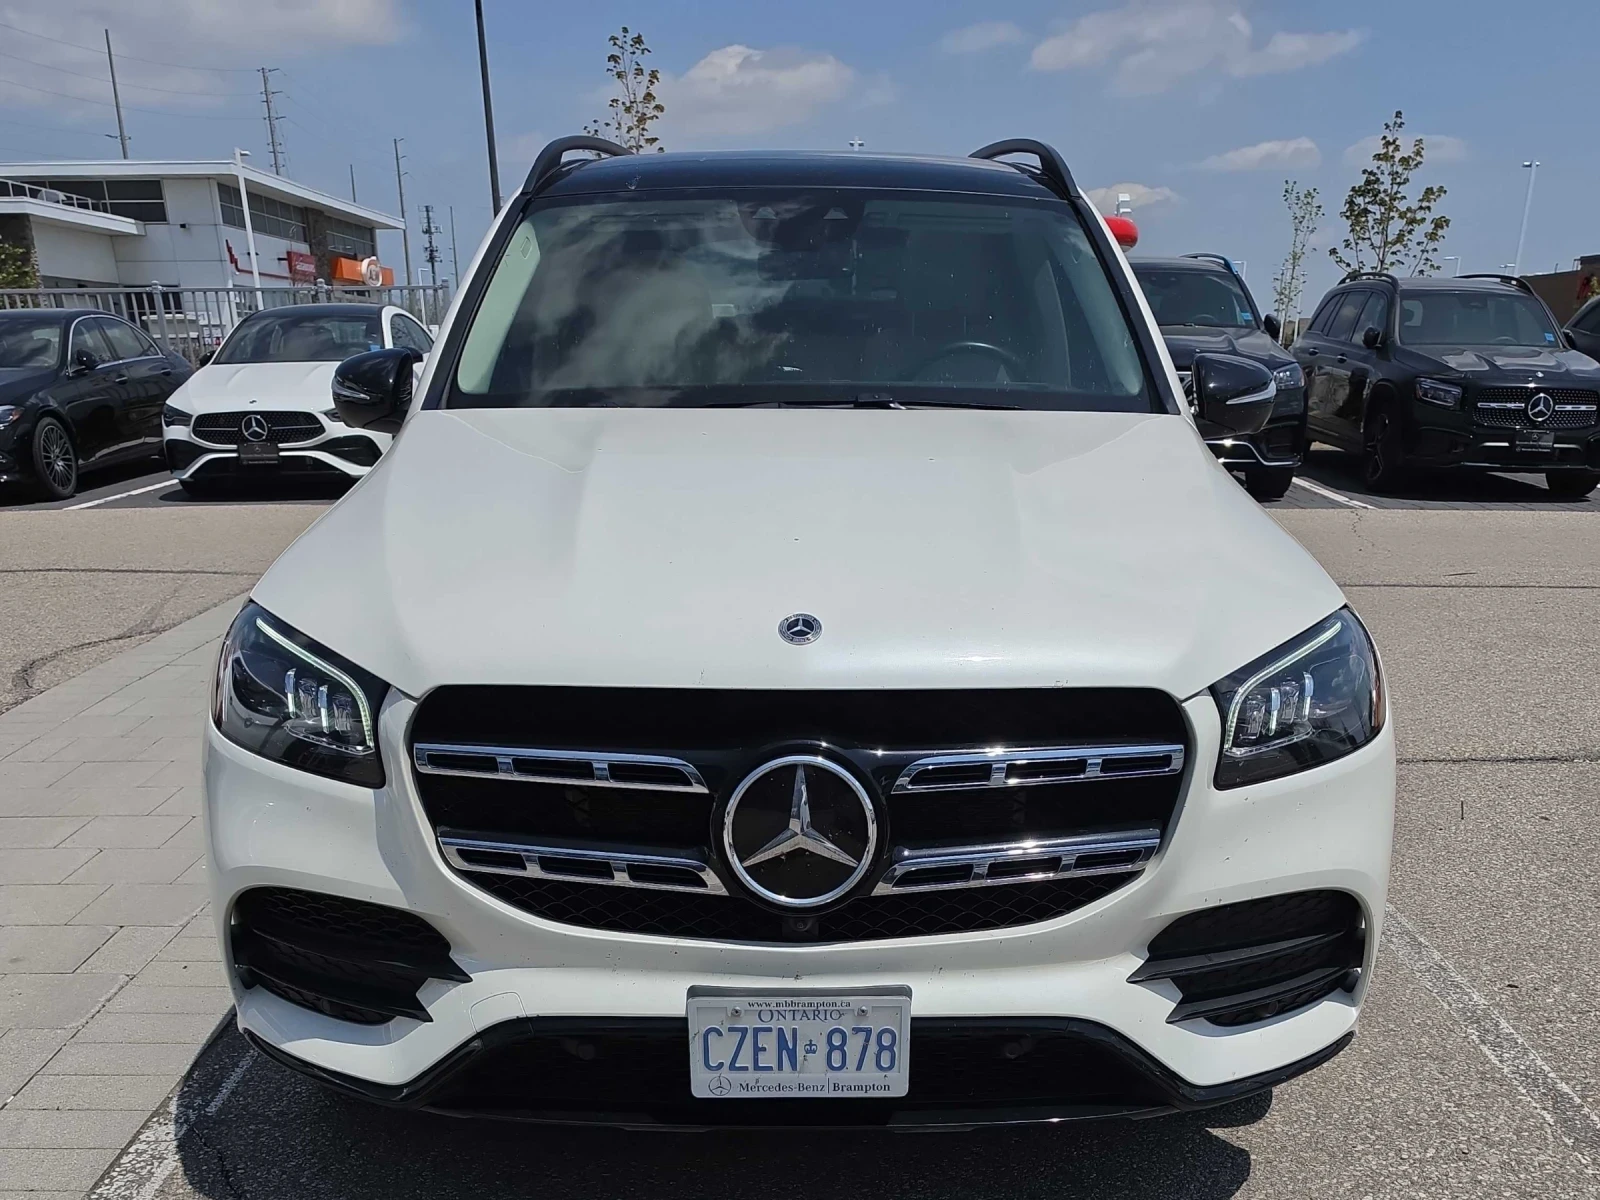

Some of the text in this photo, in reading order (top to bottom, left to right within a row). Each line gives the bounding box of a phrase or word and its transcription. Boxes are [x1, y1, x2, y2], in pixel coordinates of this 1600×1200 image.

[748, 1000, 851, 1010] www.mbbrampton.ca
[758, 1009, 841, 1023] ONTARIO
[703, 1026, 897, 1072] CZEN 878
[739, 1082, 891, 1094] Mercedes-Benz Brampton
